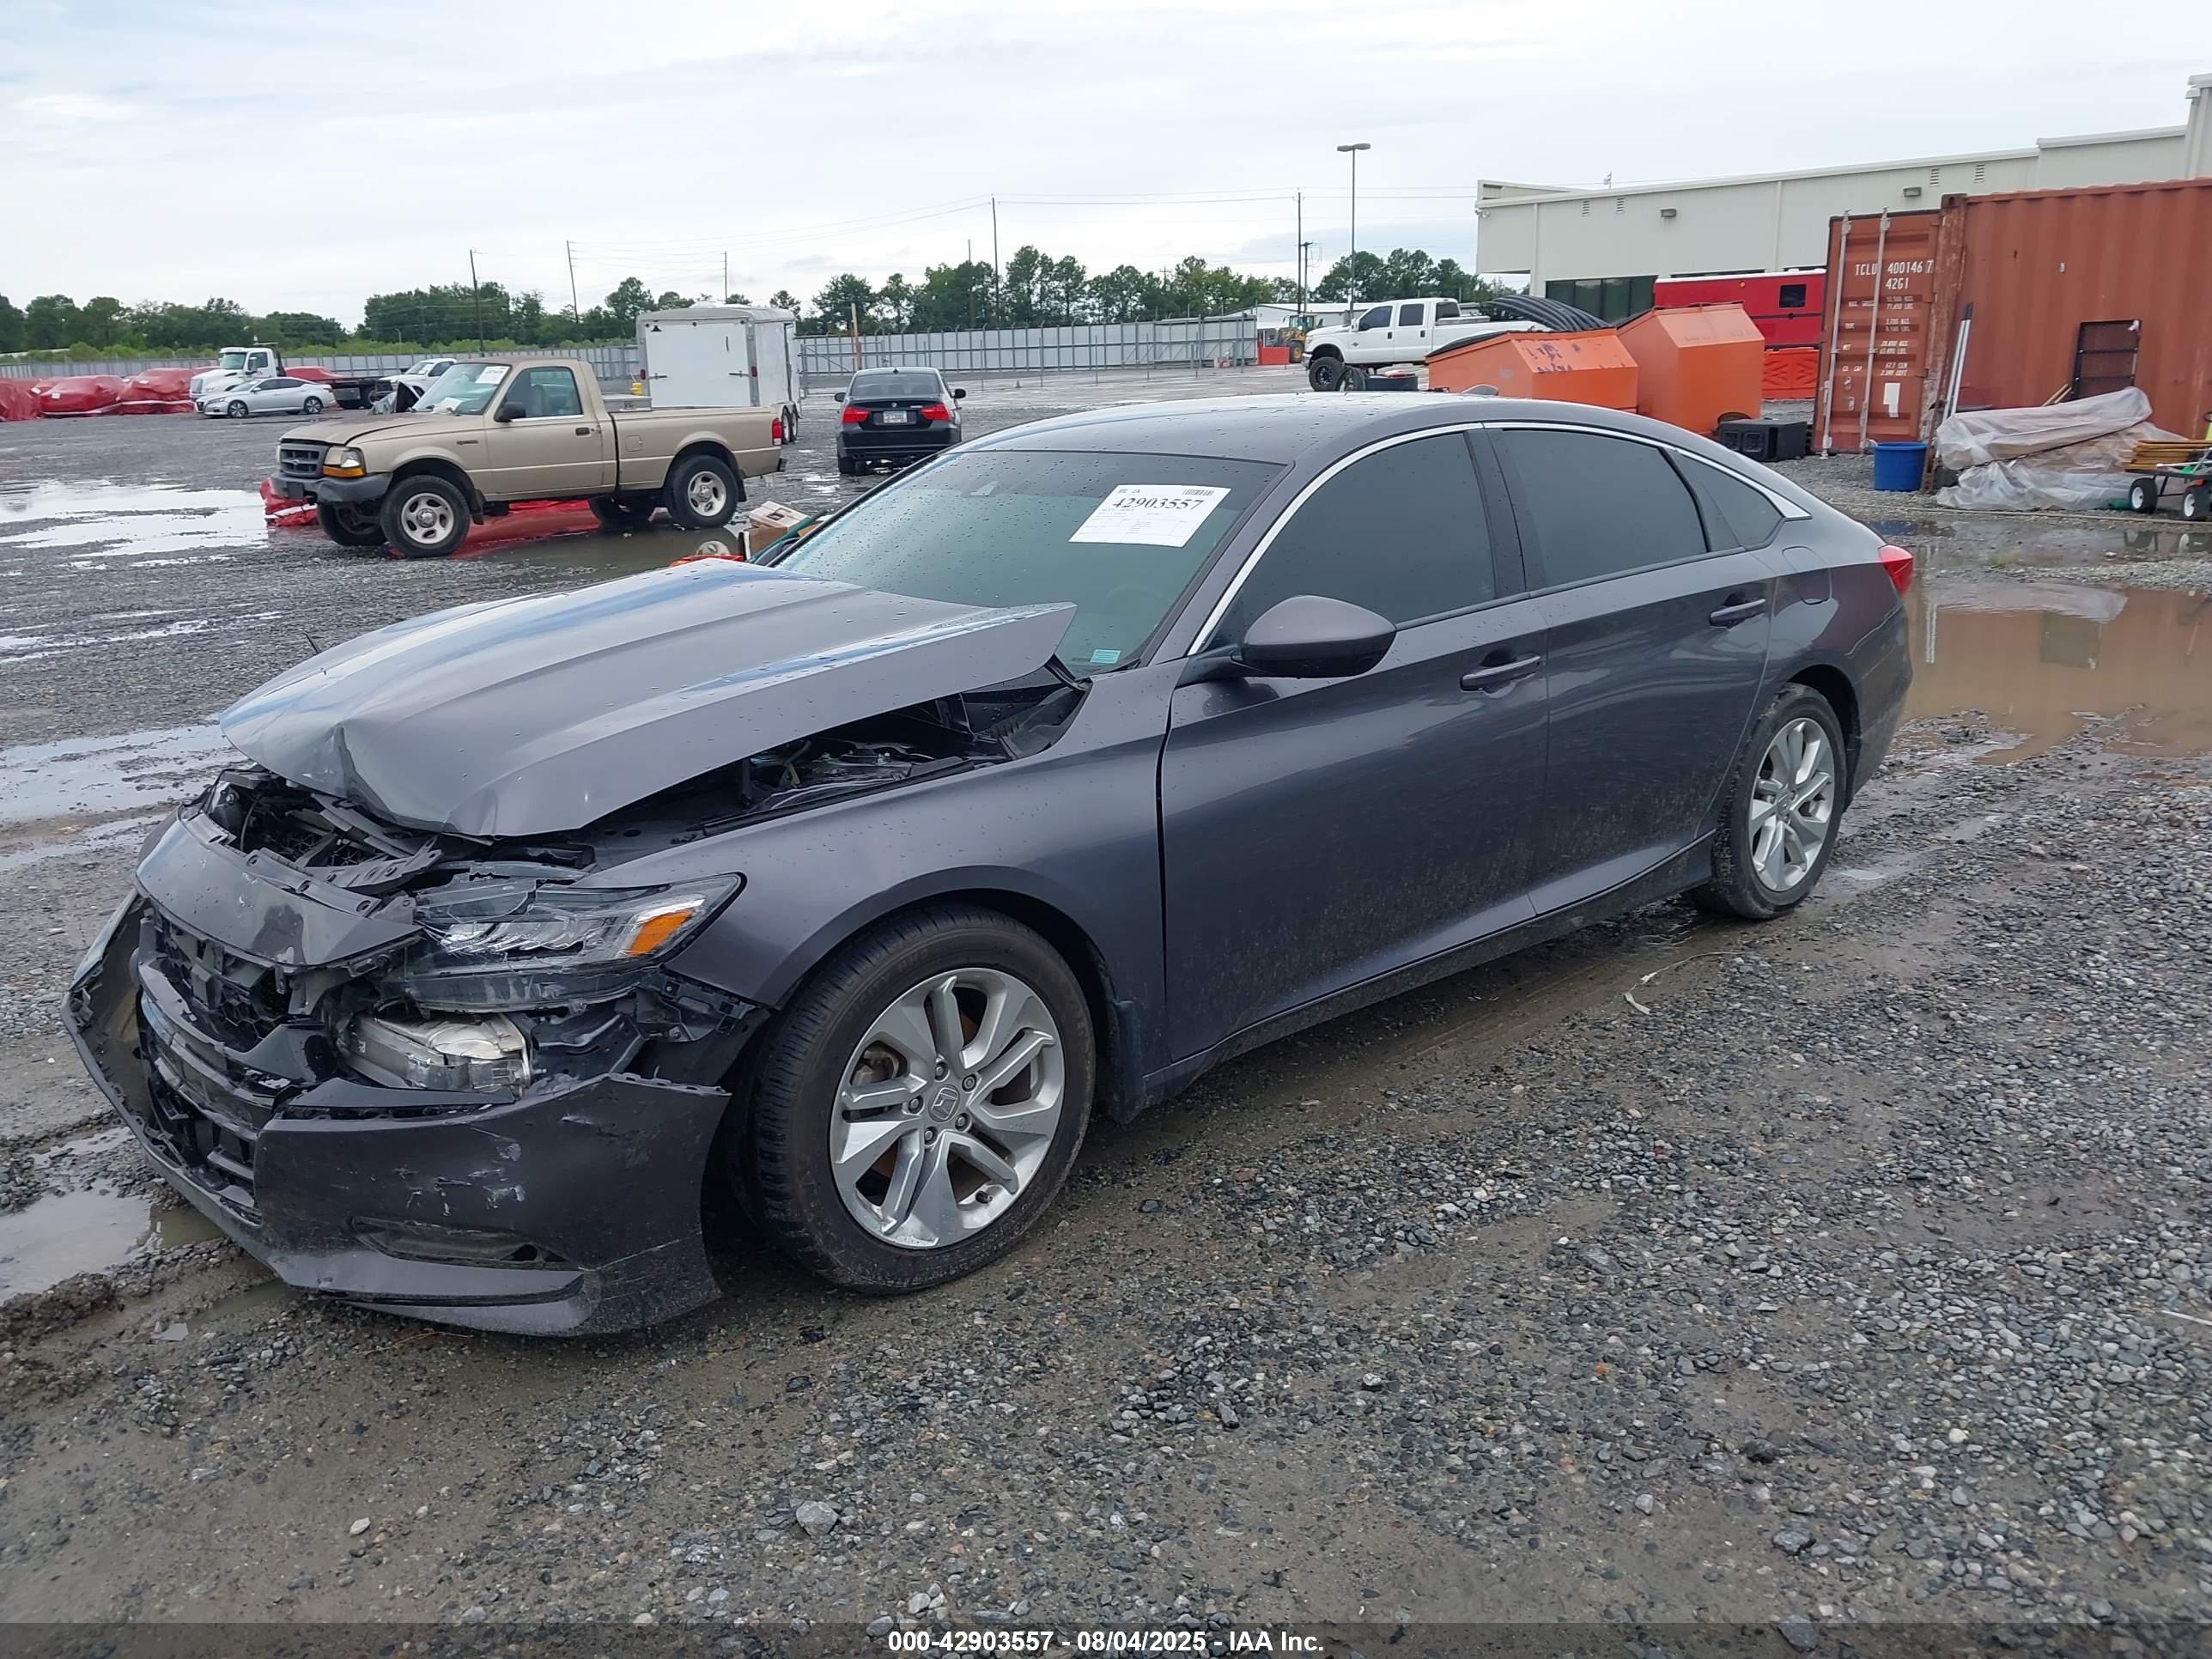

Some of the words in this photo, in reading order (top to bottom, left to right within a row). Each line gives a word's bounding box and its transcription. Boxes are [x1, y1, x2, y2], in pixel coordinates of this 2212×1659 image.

[1855, 264, 1878, 276] TCLU
[1887, 261, 1923, 274] 400146
[1885, 277, 1909, 289] 42G1
[1113, 497, 1204, 510] 42903557
